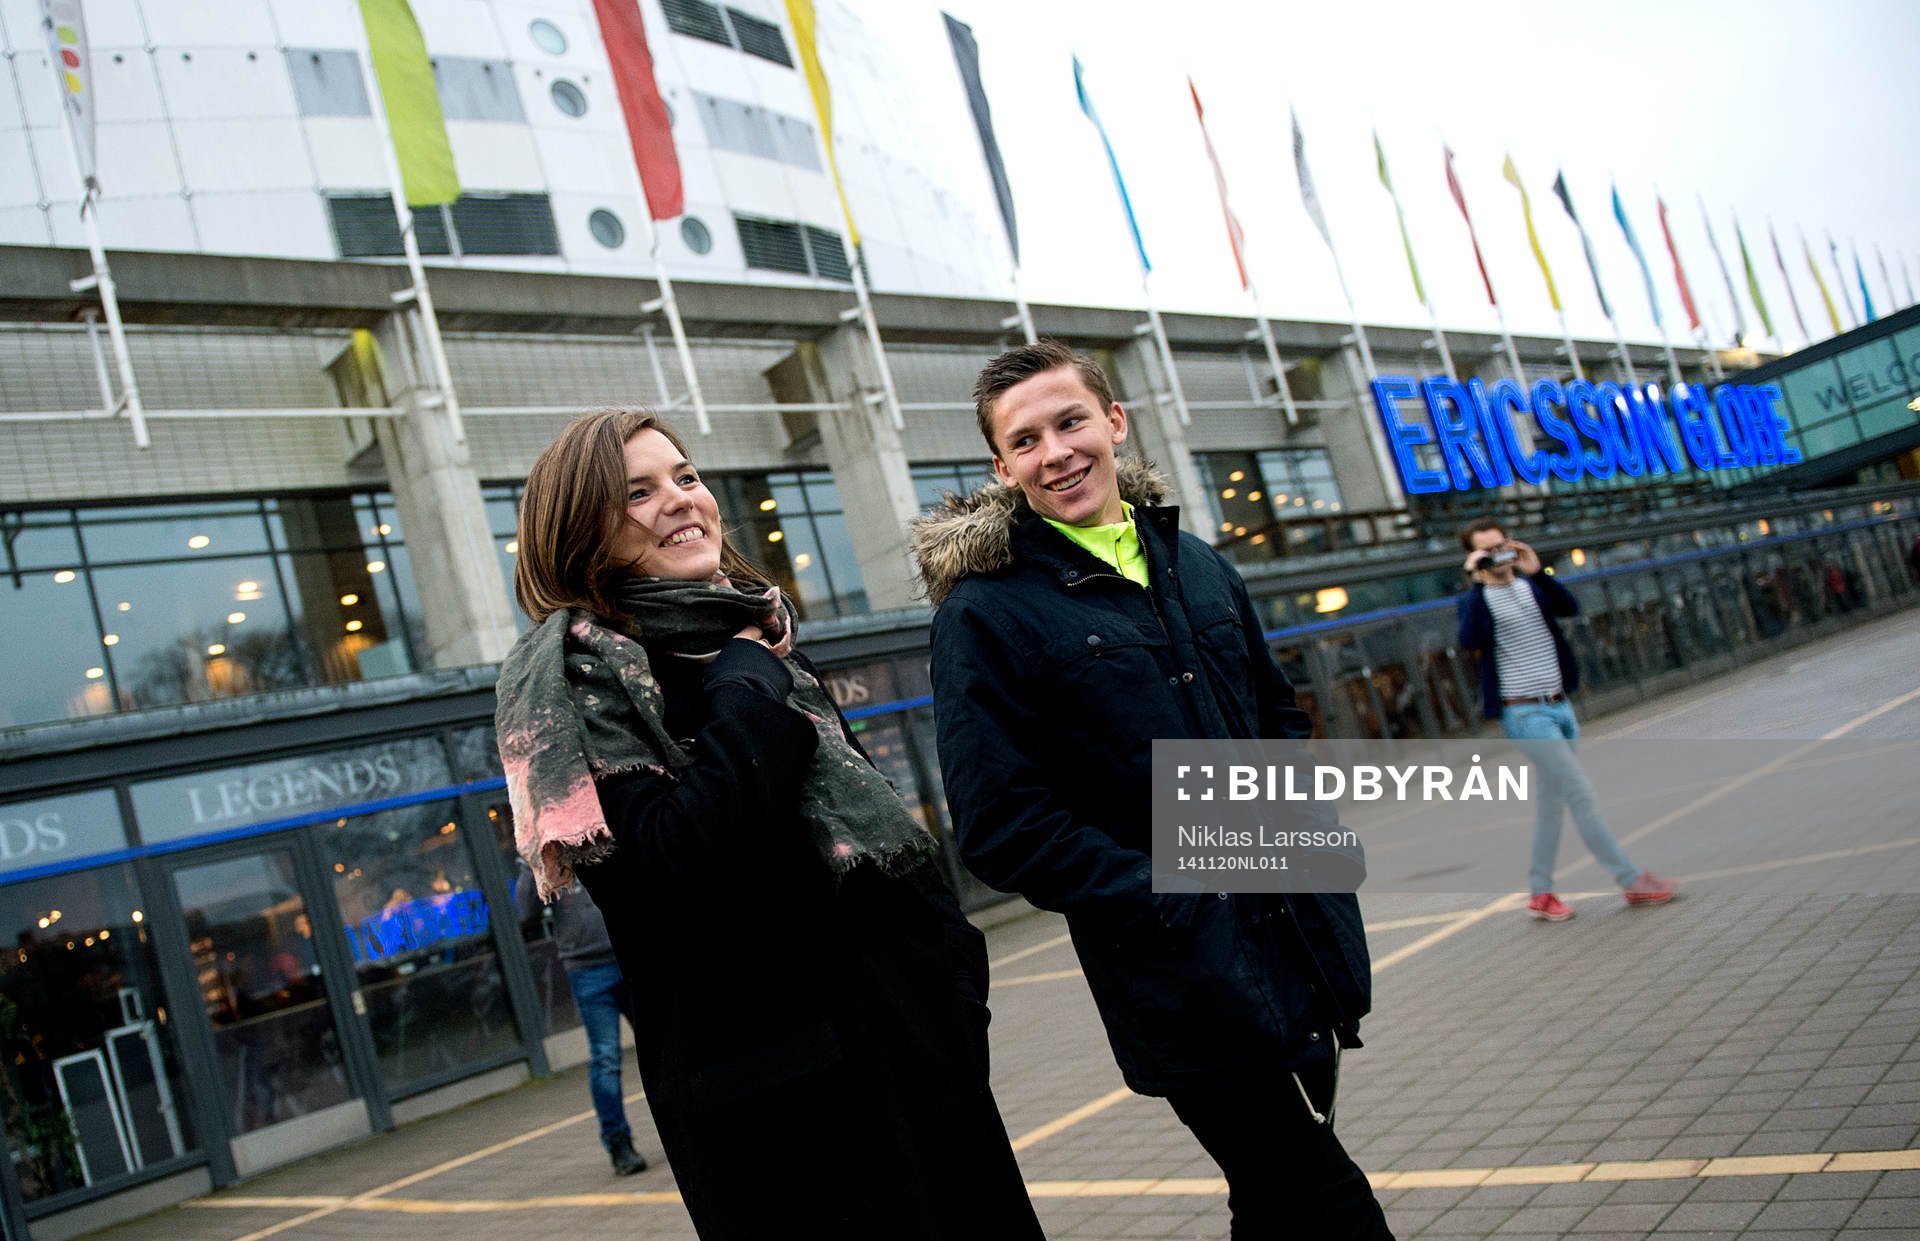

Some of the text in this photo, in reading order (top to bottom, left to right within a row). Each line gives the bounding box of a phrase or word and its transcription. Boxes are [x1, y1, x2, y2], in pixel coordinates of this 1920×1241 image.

[1372, 375, 1803, 494] ERICSSON GLOBE
[187, 754, 400, 823] LEGENDS
